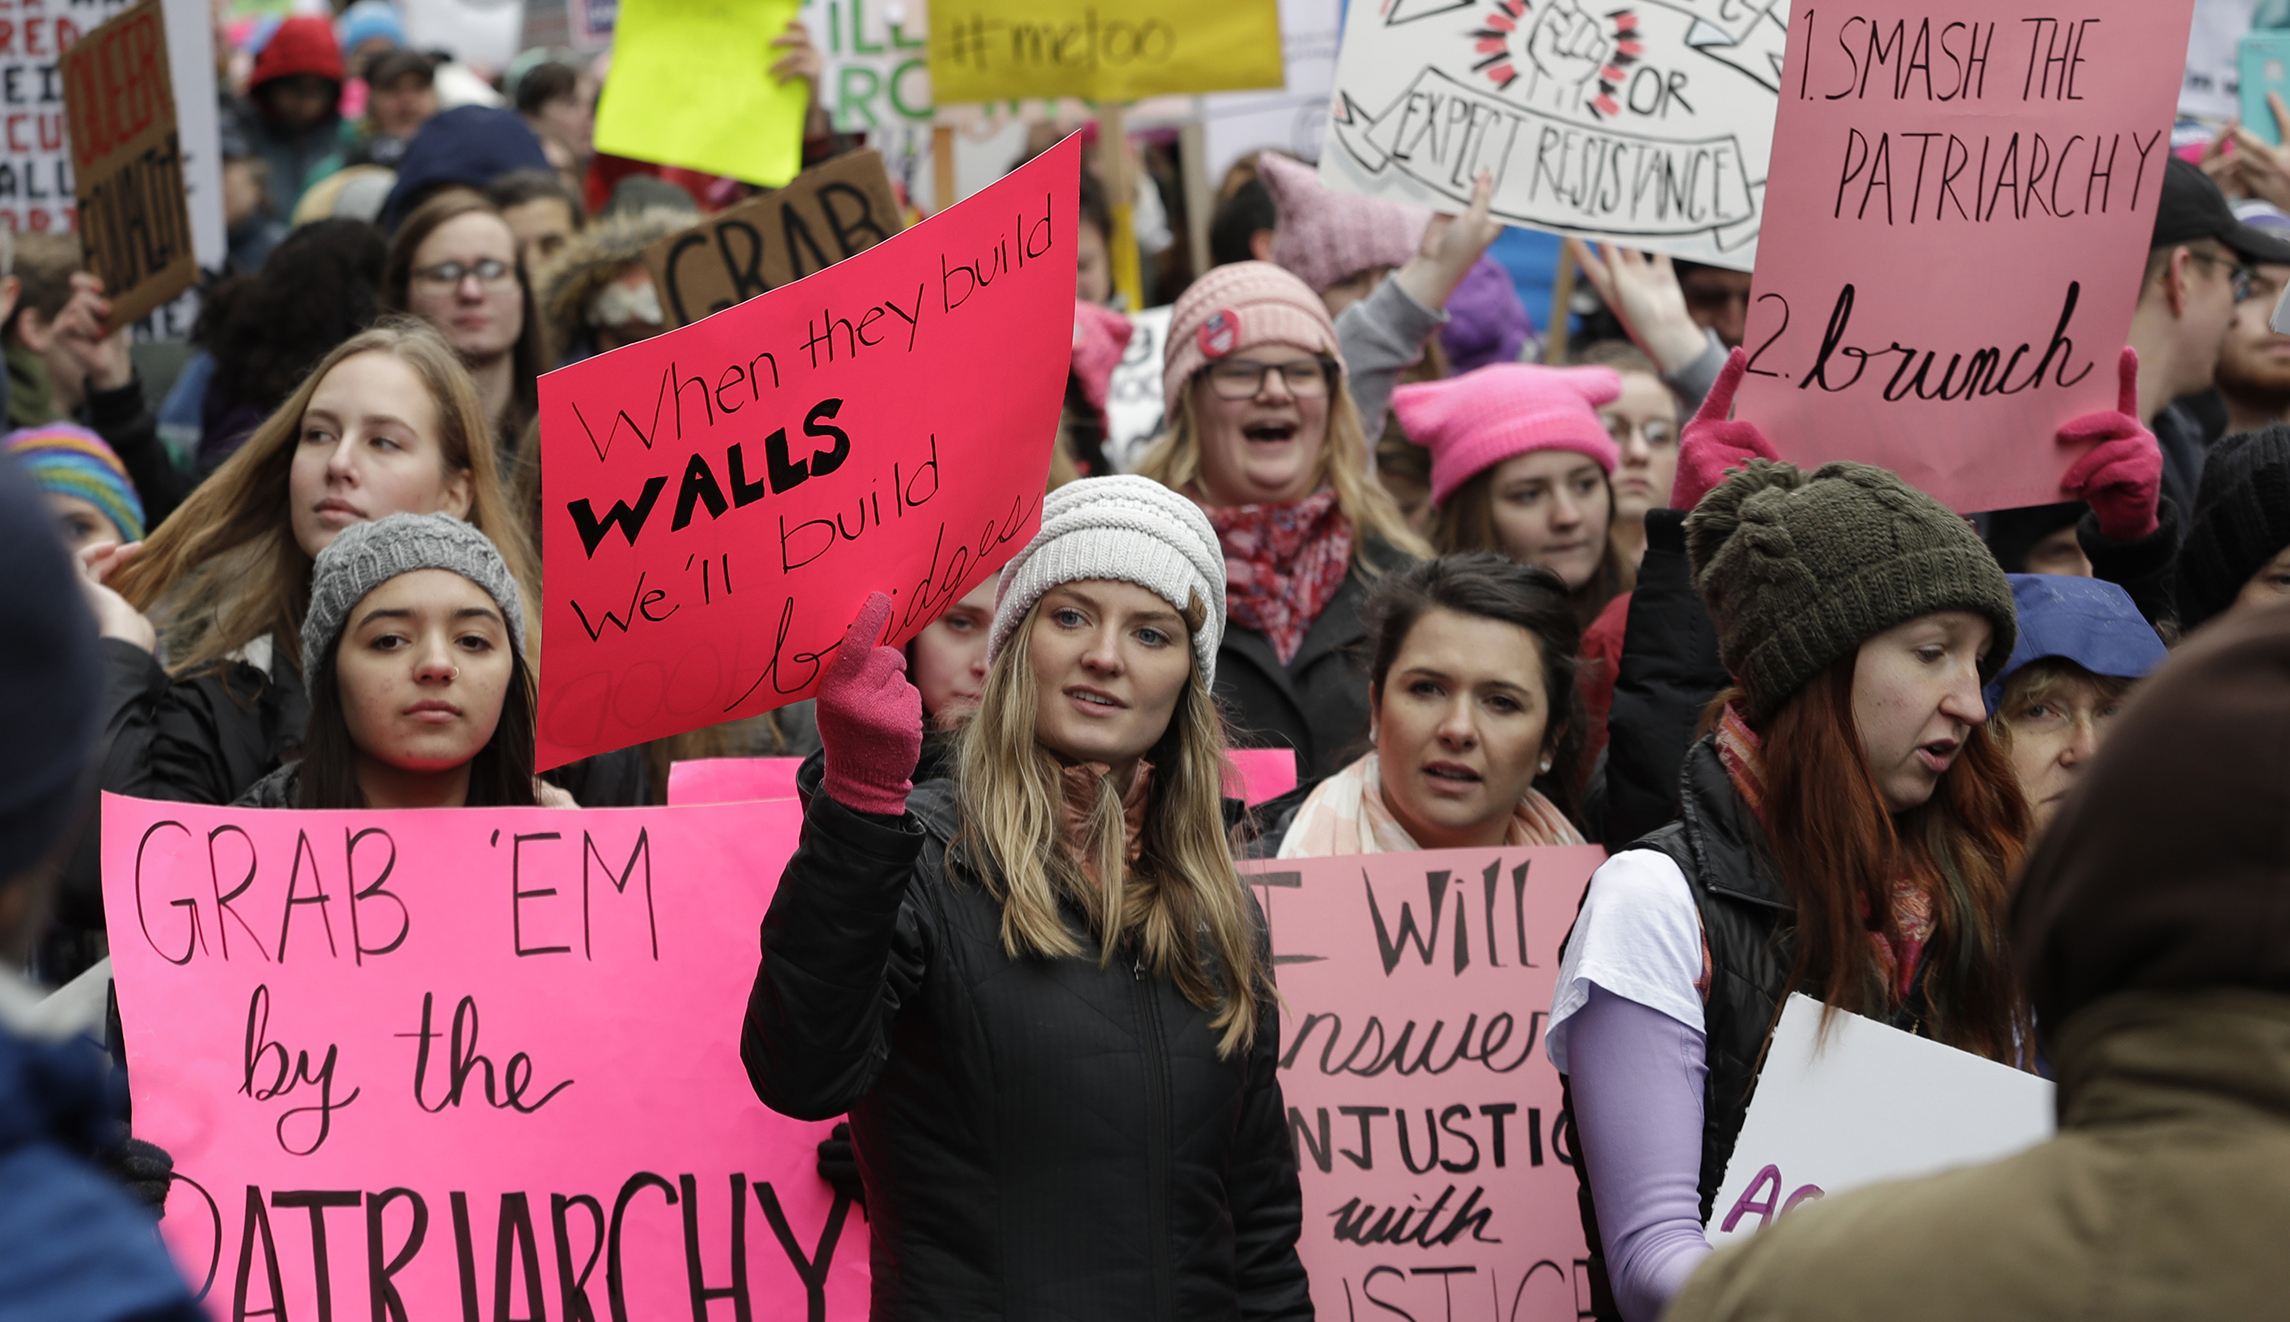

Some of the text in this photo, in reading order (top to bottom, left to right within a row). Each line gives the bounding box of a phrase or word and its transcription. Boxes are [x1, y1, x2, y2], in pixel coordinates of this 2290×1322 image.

[940, 5, 1177, 72] #metoo
[1628, 66, 1696, 120] OR
[1825, 16, 1996, 102] SMASH
[2021, 18, 2102, 101] THE
[1393, 91, 1734, 223] EXPECT RESISTANCE
[1835, 128, 2162, 226] PATRIARCHY
[665, 181, 890, 328] GRAB
[571, 192, 1053, 463] When they build
[1799, 282, 2094, 401] brunch
[566, 398, 851, 560] WALLS
[570, 433, 940, 643] We'll build
[723, 492, 1042, 713] bidges
[135, 820, 658, 967] GRAB 'EM
[1362, 857, 1540, 977] Will
[238, 984, 575, 1156] by the
[1288, 1103, 1574, 1175] NJUSTIC
[1329, 1184, 1503, 1249] with
